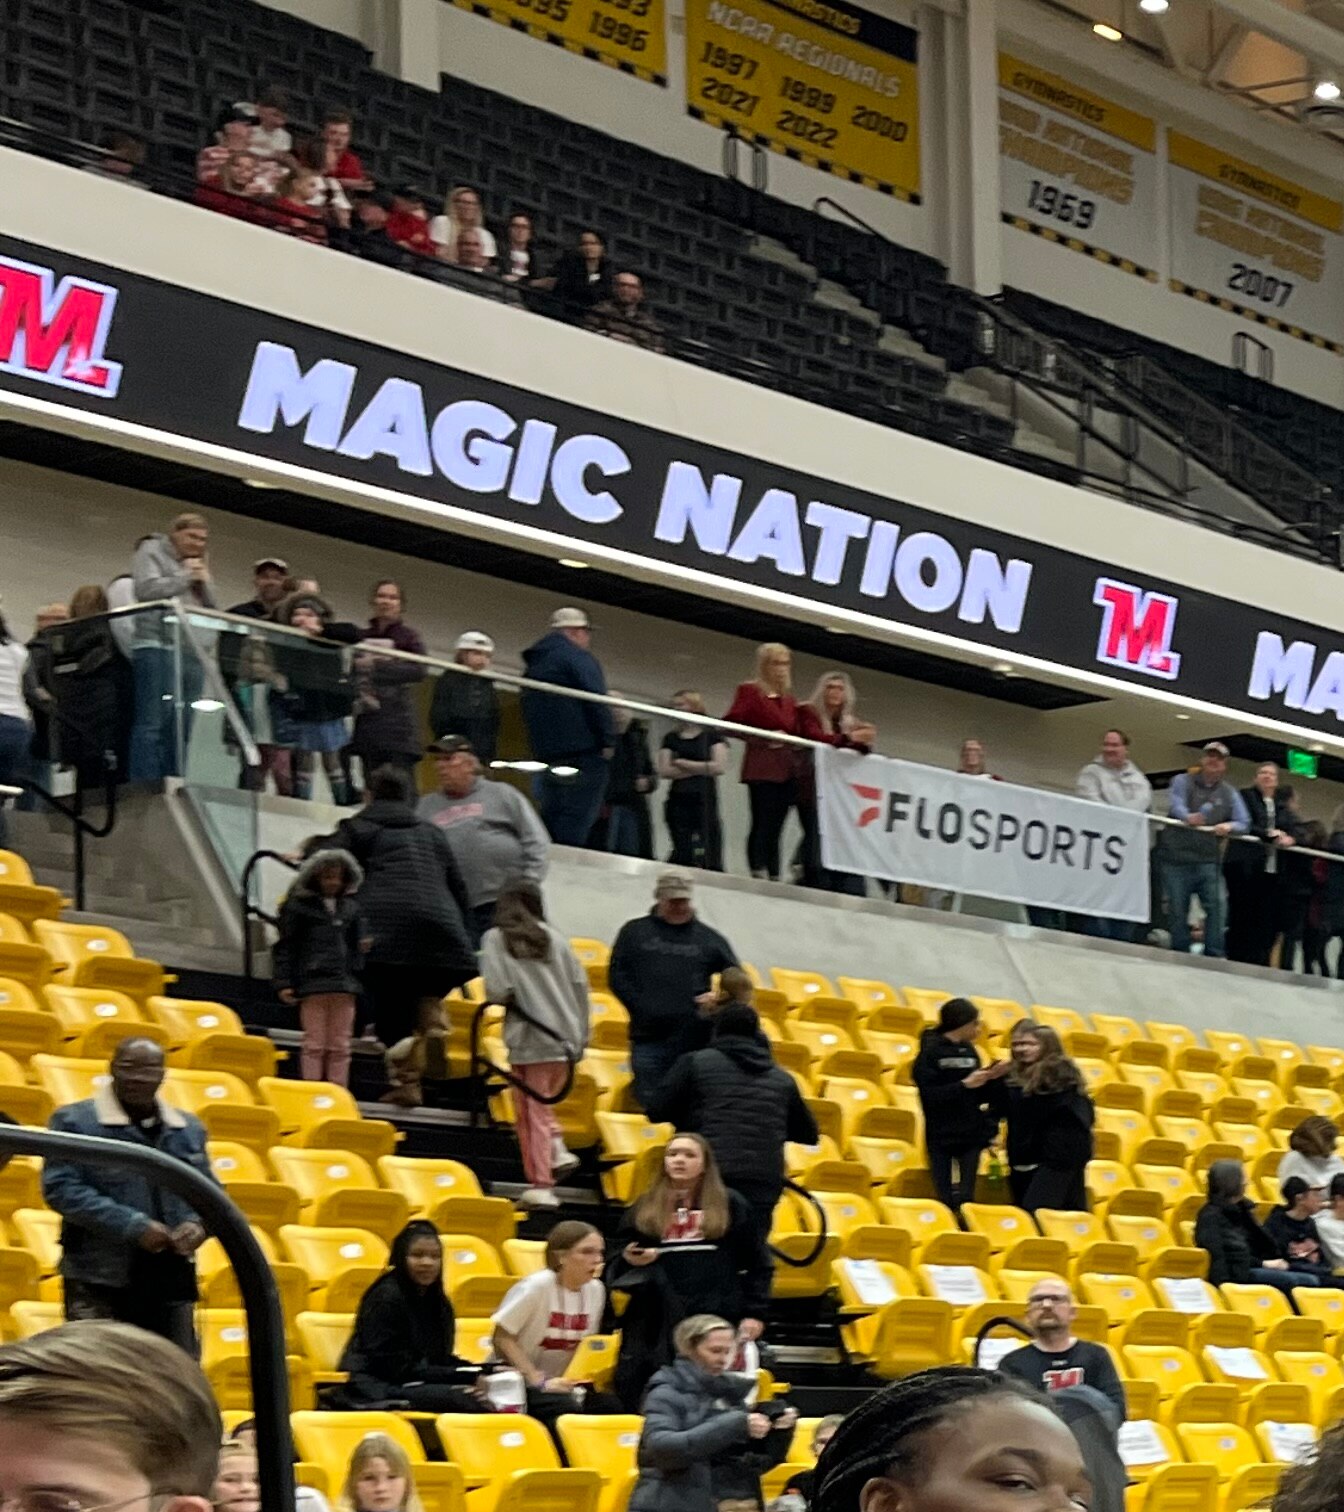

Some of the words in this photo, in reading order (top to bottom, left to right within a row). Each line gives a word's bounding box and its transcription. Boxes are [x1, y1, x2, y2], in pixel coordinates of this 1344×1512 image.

[700, 77, 760, 117] 2021
[776, 110, 839, 149] 2022
[1028, 179, 1097, 230] 1969
[1227, 263, 1294, 308] 2007
[238, 341, 632, 525] MAGIC
[654, 460, 1032, 633] NATION
[885, 791, 1128, 876] FLOSPORTS
